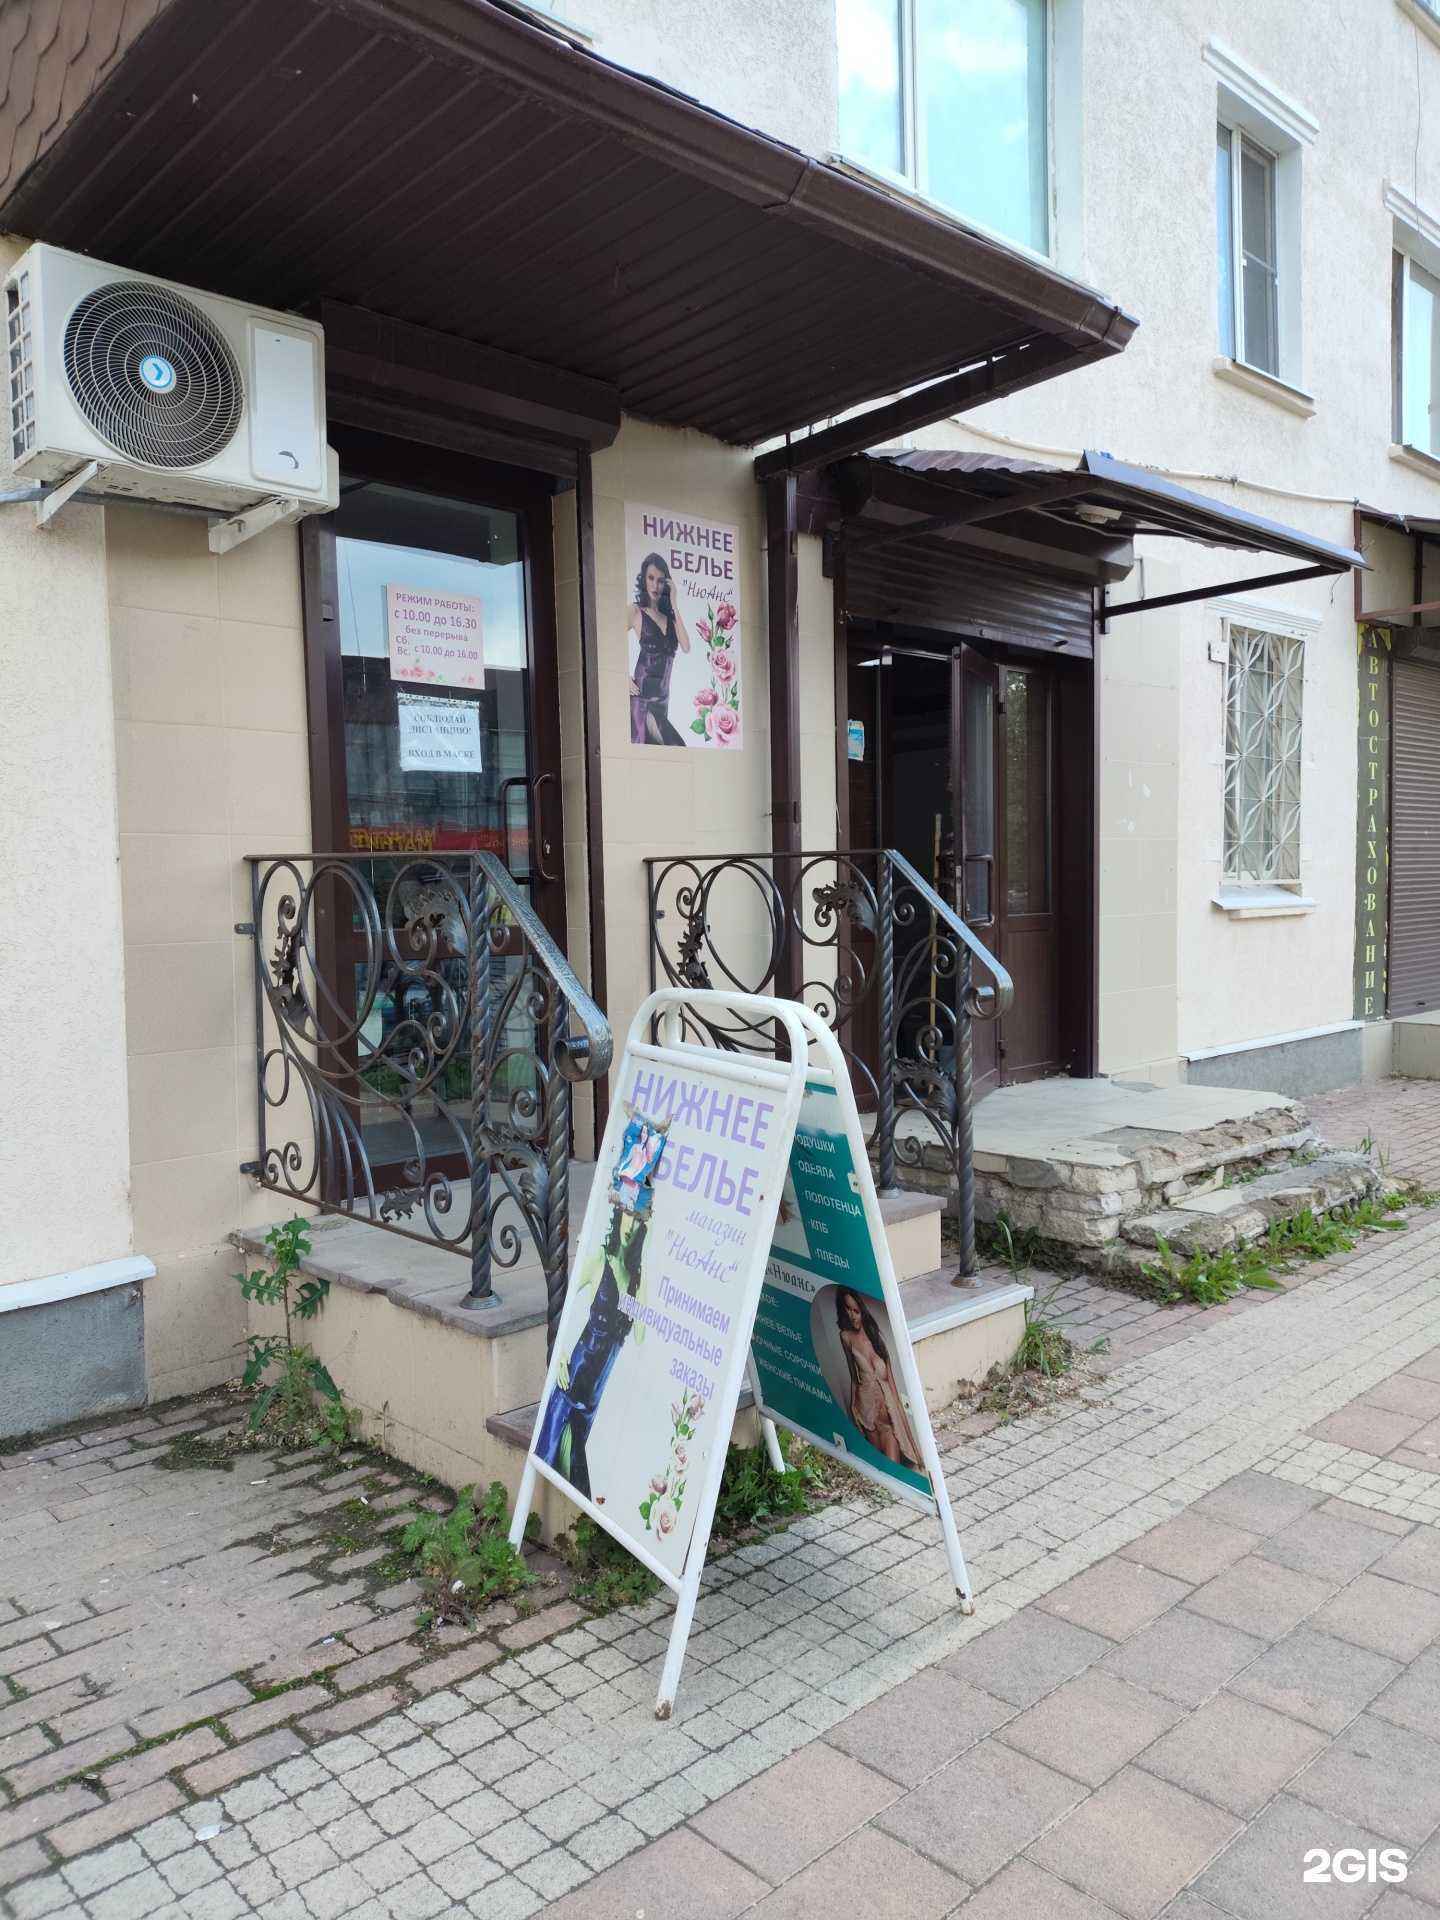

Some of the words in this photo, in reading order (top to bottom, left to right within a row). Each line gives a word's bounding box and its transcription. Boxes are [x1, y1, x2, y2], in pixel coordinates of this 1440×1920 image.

[643, 514, 733, 553] НИЖНЕЕ
[670, 548, 733, 580] БЕЛЬЕ
[396, 592, 432, 606] РЕЖИМ
[434, 599, 476, 613] РАБОТЫ:
[402, 608, 431, 623] 10.00
[433, 617, 447, 626] до
[450, 616, 477, 629] 16.30
[395, 635, 410, 645] Сб.
[405, 624, 421, 635] без
[423, 628, 468, 642] перерыва
[397, 646, 411, 656] Вс.
[421, 645, 443, 656] 10.00
[444, 649, 455, 658] до
[457, 648, 478, 660] 16.00
[1362, 629, 1379, 1017] АВТОСТРАХОВАНИЕ
[631, 1069, 774, 1150] НИЖНЕЕ
[657, 1275, 732, 1336] Принимаем
[669, 1357, 715, 1401] заказы
